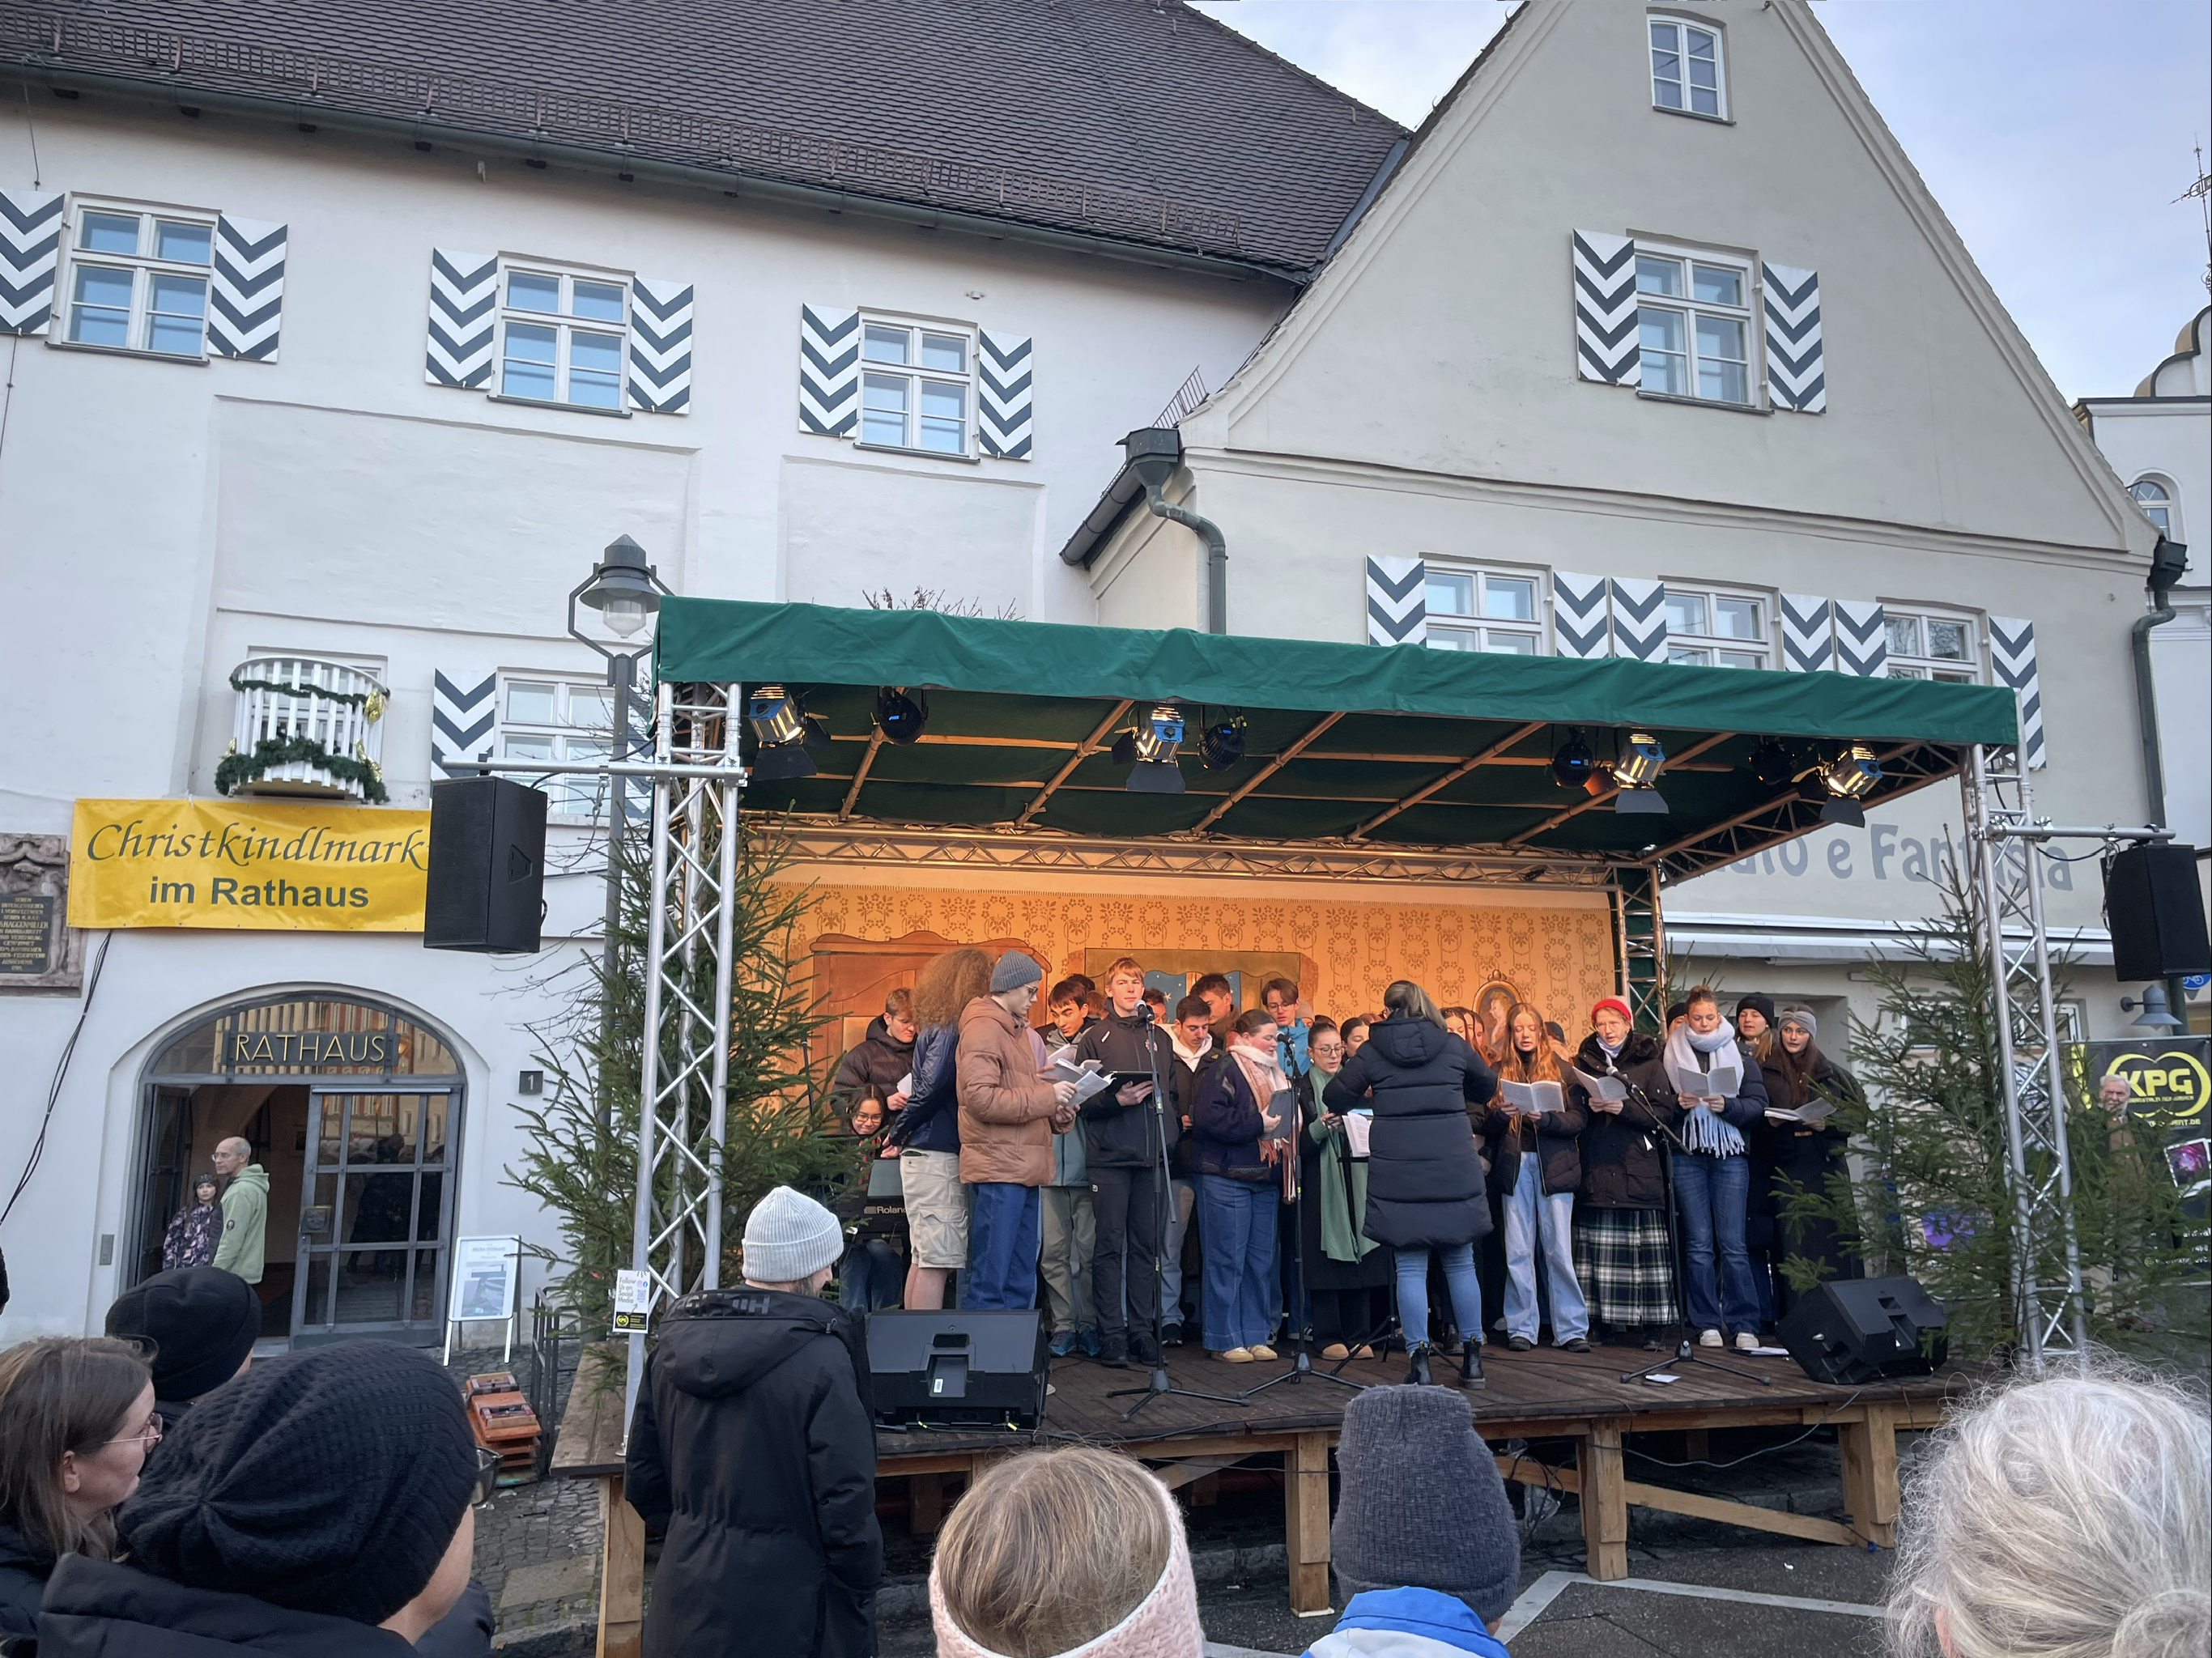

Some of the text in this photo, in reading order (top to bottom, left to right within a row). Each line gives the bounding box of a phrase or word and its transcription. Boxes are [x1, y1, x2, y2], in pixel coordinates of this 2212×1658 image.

[87, 820, 431, 872] Christkindlmark
[1827, 838, 1853, 879] e
[150, 876, 369, 908] im Rathaus
[236, 1034, 385, 1062] RATHAUS
[528, 1074, 534, 1090] 1
[2117, 1067, 2194, 1097] KPG
